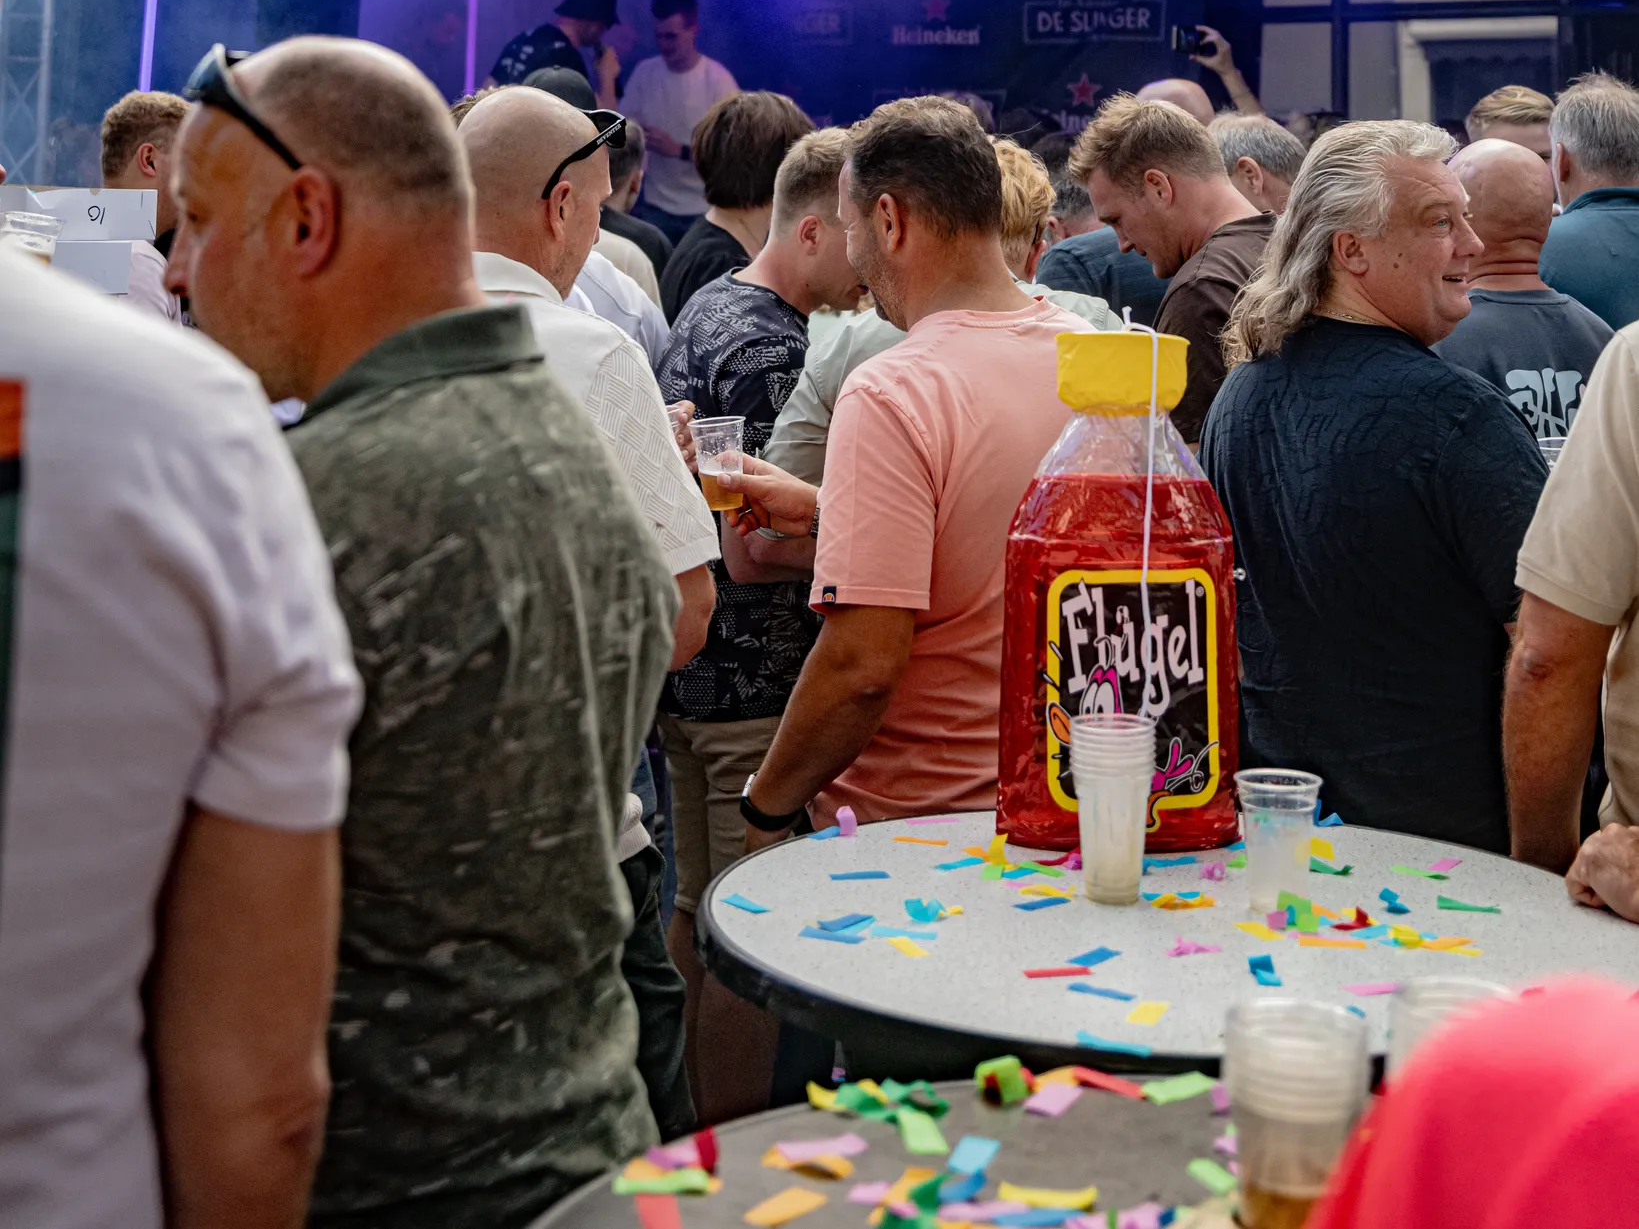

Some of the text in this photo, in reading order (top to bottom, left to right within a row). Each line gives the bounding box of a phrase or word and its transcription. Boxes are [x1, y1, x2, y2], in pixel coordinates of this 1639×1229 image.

[1036, 10, 1065, 33] DE
[892, 24, 979, 45] Heineken
[1062, 578, 1204, 717] Flügel
